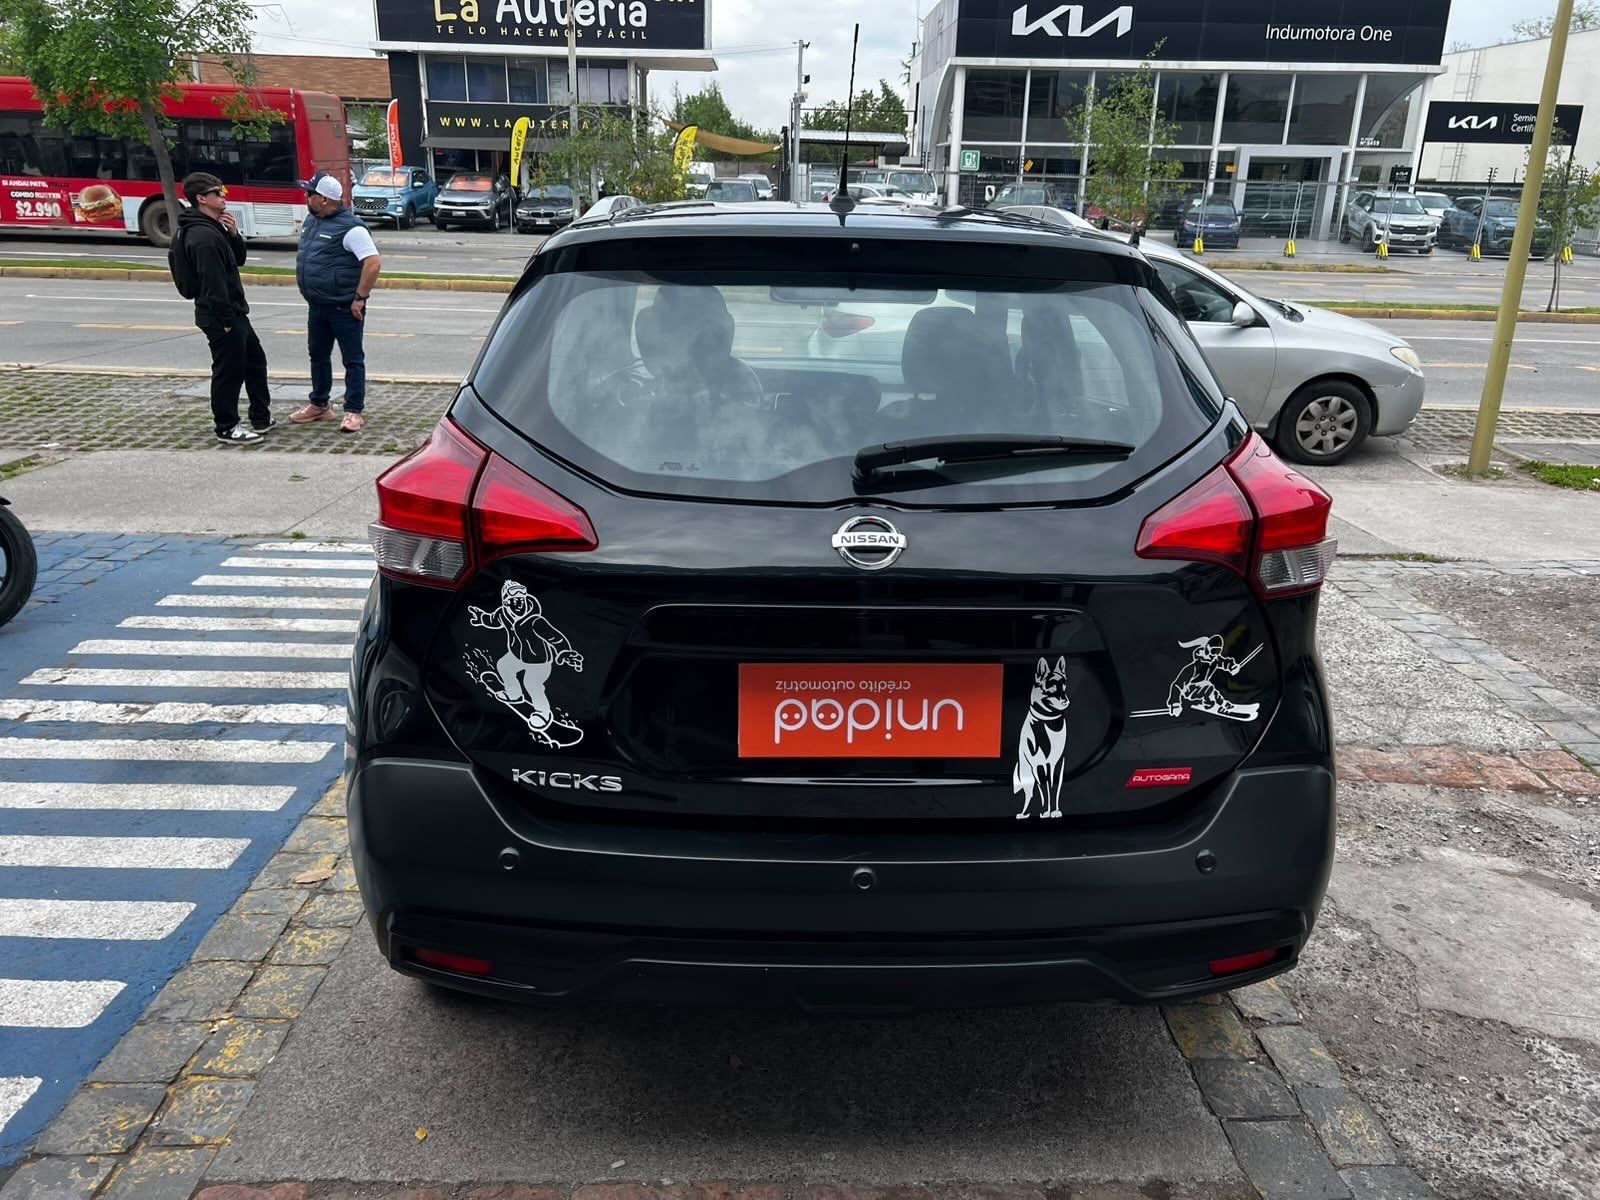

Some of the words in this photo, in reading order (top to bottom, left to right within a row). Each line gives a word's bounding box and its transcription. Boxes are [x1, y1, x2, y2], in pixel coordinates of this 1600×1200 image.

[434, 0, 479, 22] La
[1011, 3, 1133, 38] KIA
[436, 25, 455, 34] TE
[468, 26, 487, 35] LO
[596, 28, 647, 40] FÁCIL
[1265, 23, 1356, 41] Indumotora
[1359, 25, 1393, 42] One
[440, 116, 590, 130] WWW.LAUTERA
[1448, 114, 1499, 129] KIA
[1512, 113, 1559, 124] Semins
[15, 200, 61, 217] $2.990
[841, 534, 899, 545] NISSAN
[775, 680, 856, 693] automotriz
[859, 680, 911, 693] crédito
[774, 698, 964, 744] unidad
[511, 768, 623, 792] KICKS
[1132, 773, 1190, 782] AUTOGAMA
